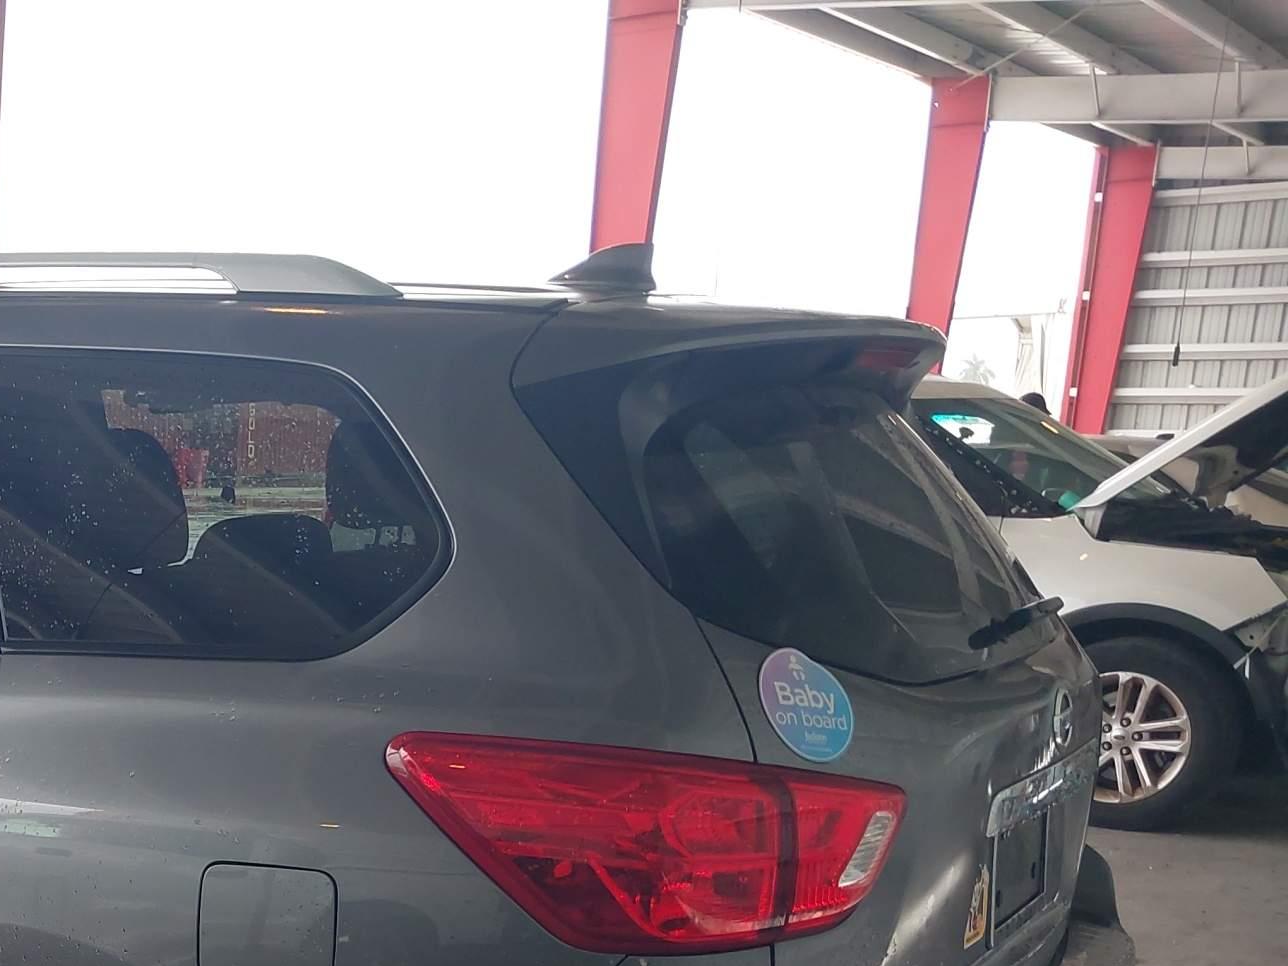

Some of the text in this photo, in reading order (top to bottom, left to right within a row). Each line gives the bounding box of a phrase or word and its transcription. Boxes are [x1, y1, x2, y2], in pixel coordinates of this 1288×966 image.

[774, 681, 835, 714] Baby
[775, 709, 849, 731] on board
